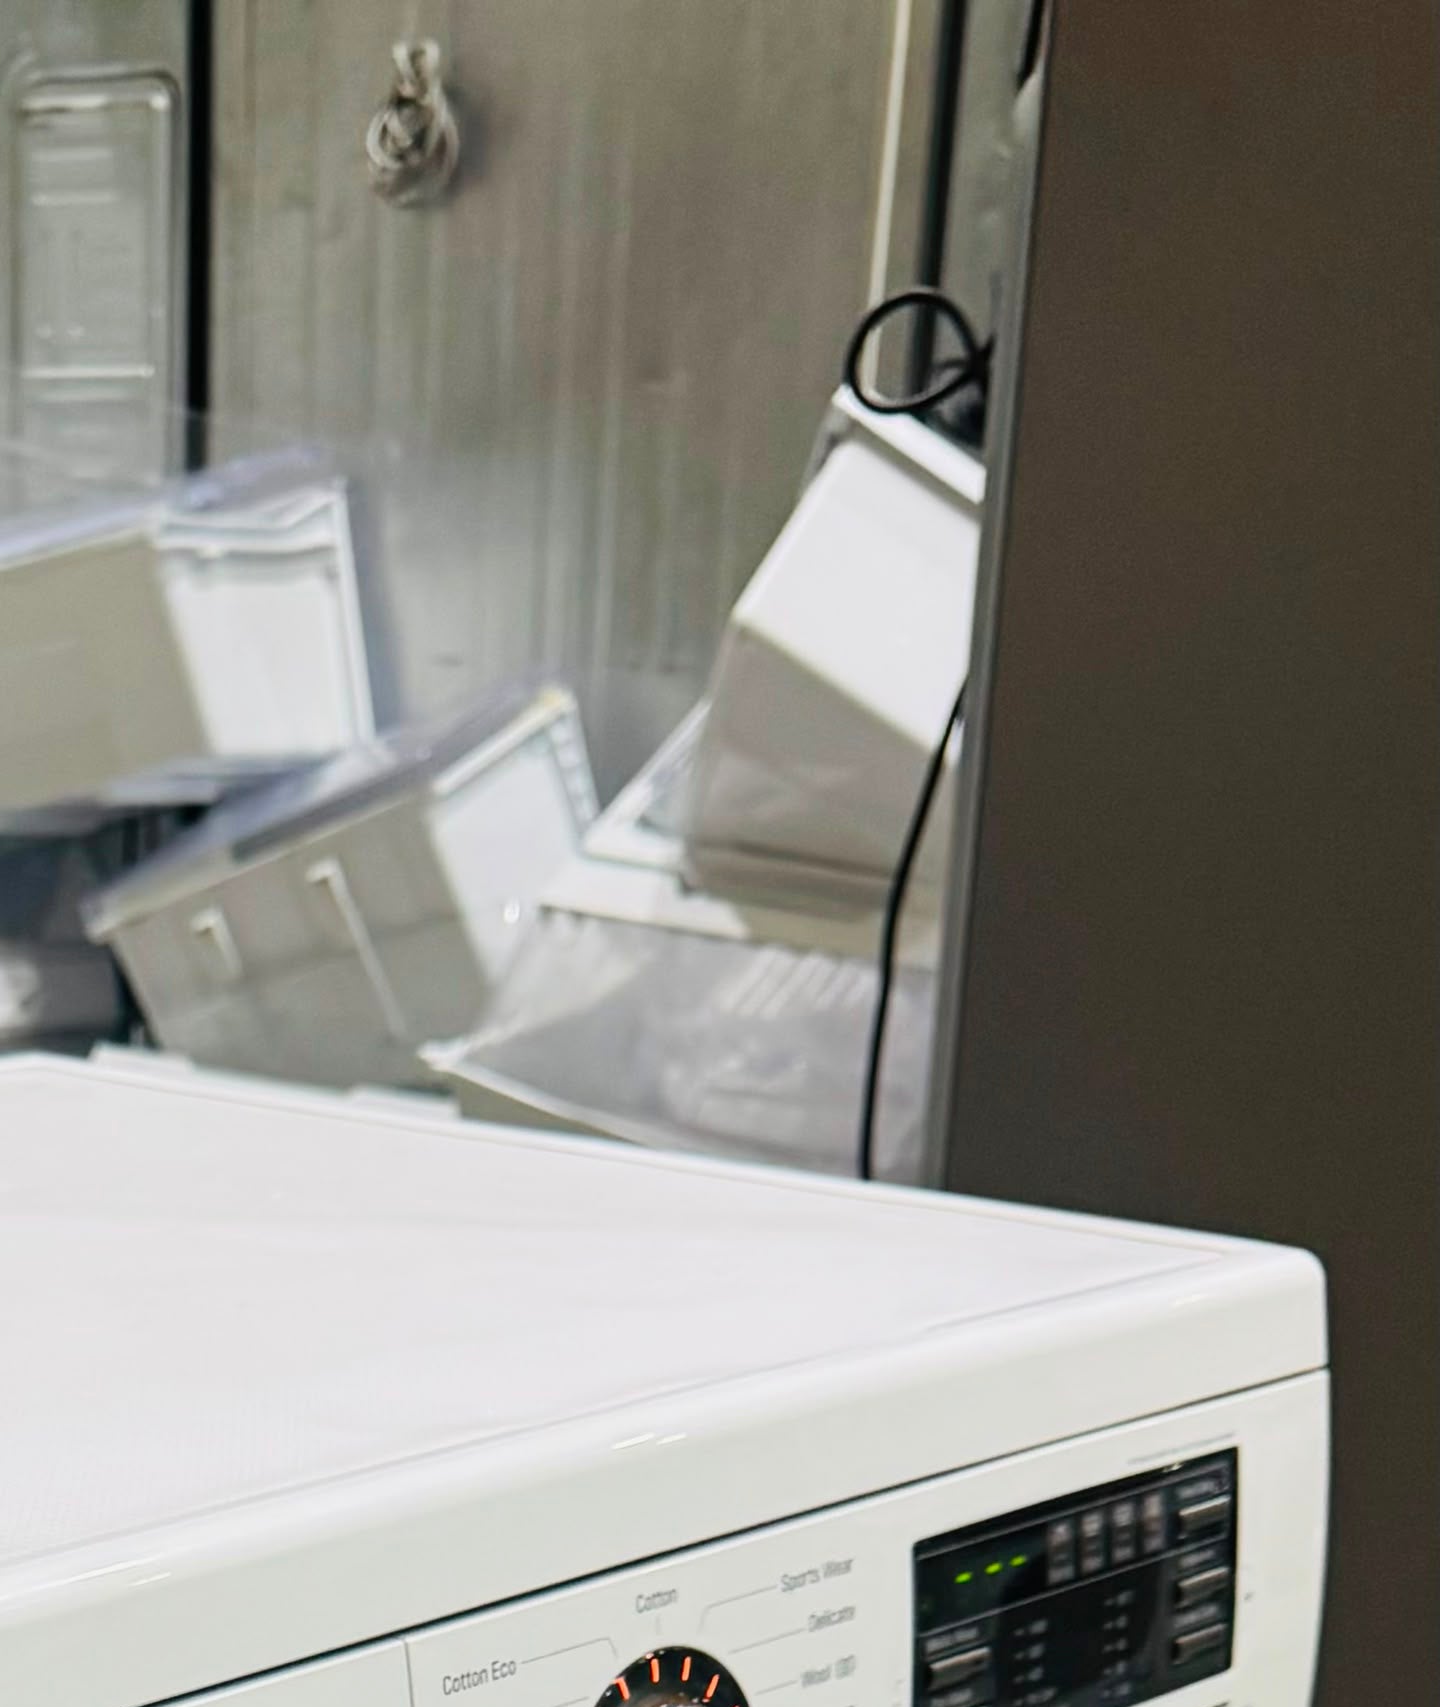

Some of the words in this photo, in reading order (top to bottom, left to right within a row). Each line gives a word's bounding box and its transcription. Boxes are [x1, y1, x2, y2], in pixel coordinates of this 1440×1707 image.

[635, 1588, 678, 1614] Cotton
[442, 1668, 488, 1695] Cotton
[491, 1660, 516, 1681] Eco
